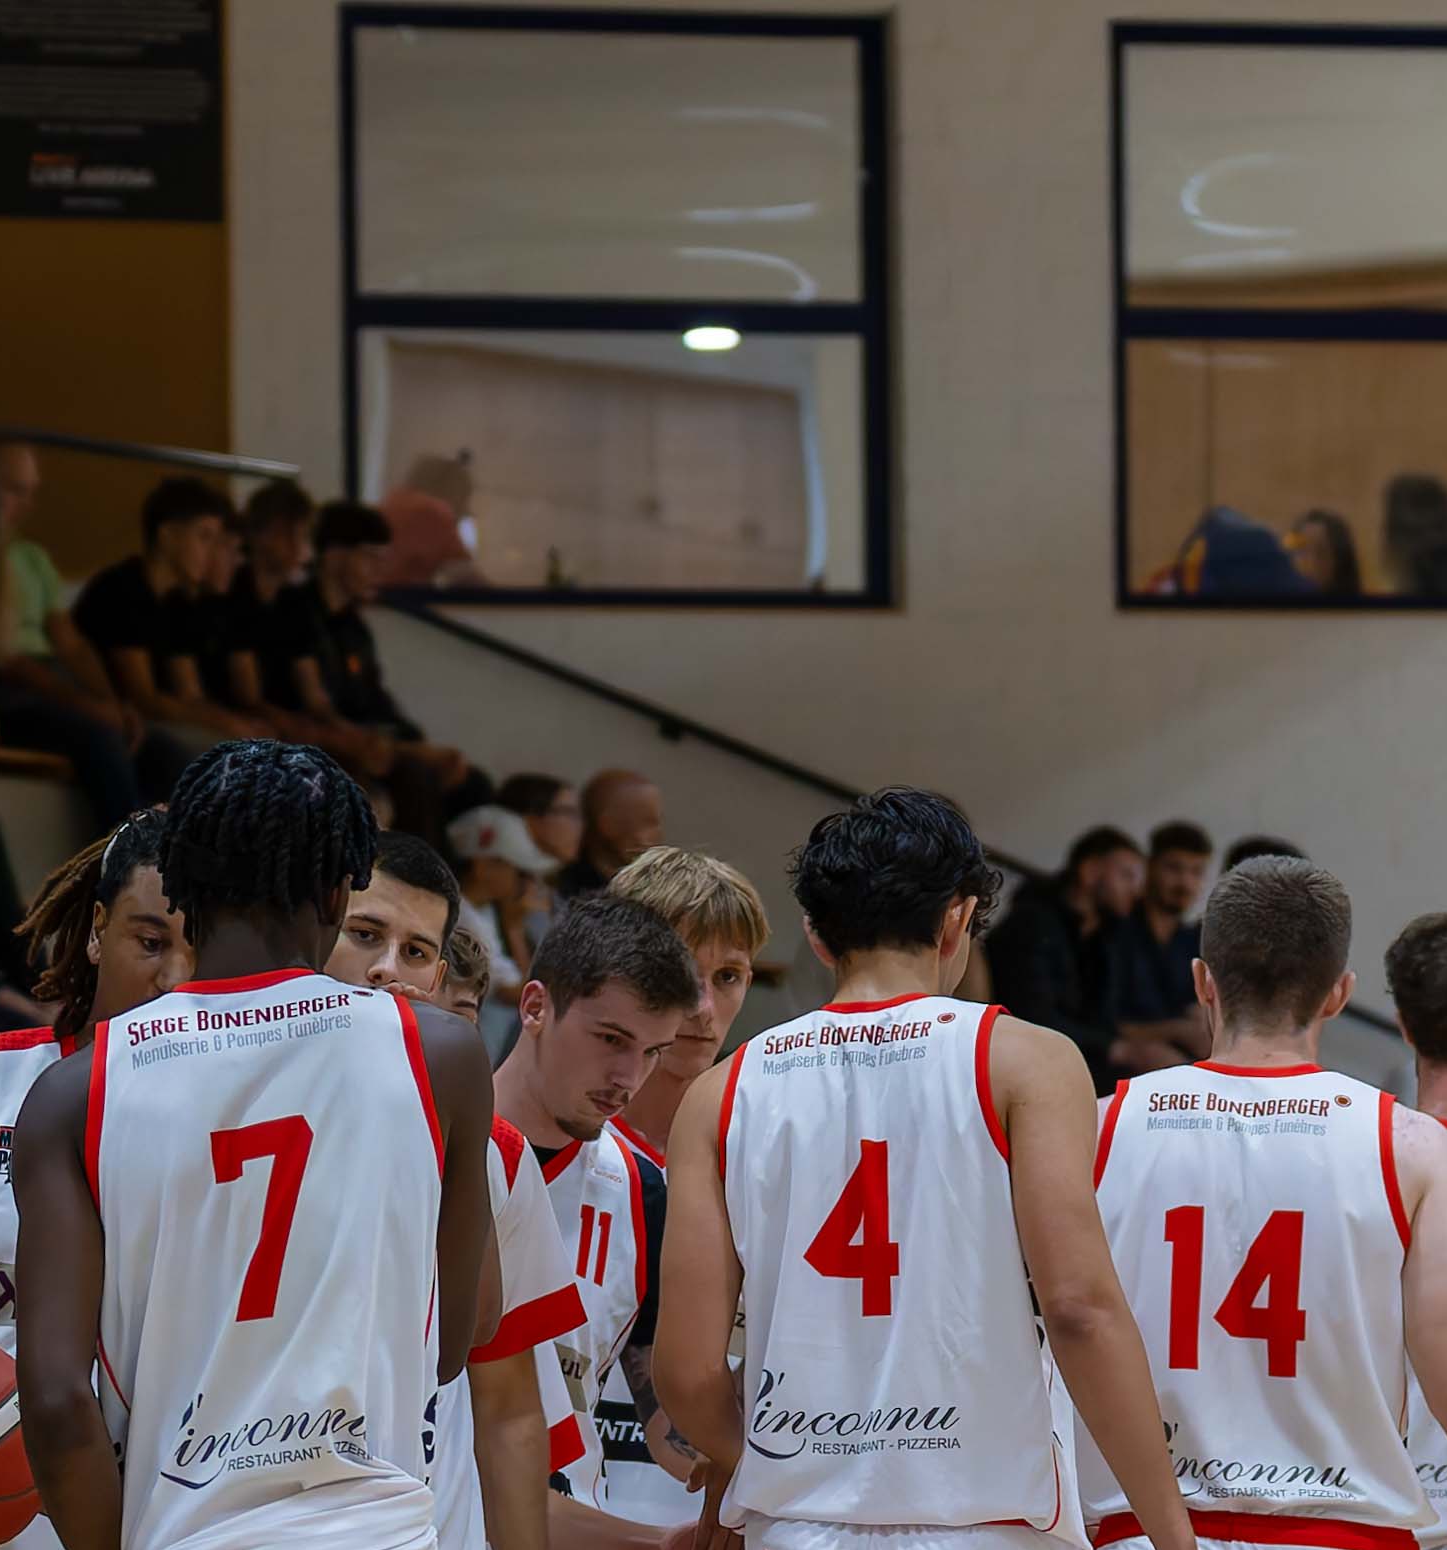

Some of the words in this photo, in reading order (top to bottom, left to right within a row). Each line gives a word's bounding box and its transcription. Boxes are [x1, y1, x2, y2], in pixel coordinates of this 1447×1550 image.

[127, 1015, 189, 1046] SERGE
[197, 994, 350, 1031] BONENBERGER
[132, 1038, 209, 1069] Menuiserie
[227, 1025, 283, 1049] Pompes
[288, 1013, 351, 1038] Funèbres
[764, 1032, 815, 1055] SERGE
[1147, 1116, 1212, 1131] Menuiserie
[1148, 1092, 1200, 1112] SERGE
[1206, 1092, 1330, 1118] BONENBERGER
[210, 1114, 314, 1322] 7
[803, 1139, 899, 1318] 4
[576, 1205, 612, 1287] 11
[1164, 1205, 1306, 1378] 14
[227, 1446, 322, 1471] RESTAURANT
[897, 1438, 961, 1450] PIZZERIA
[1207, 1486, 1286, 1499] RESTAURANT
